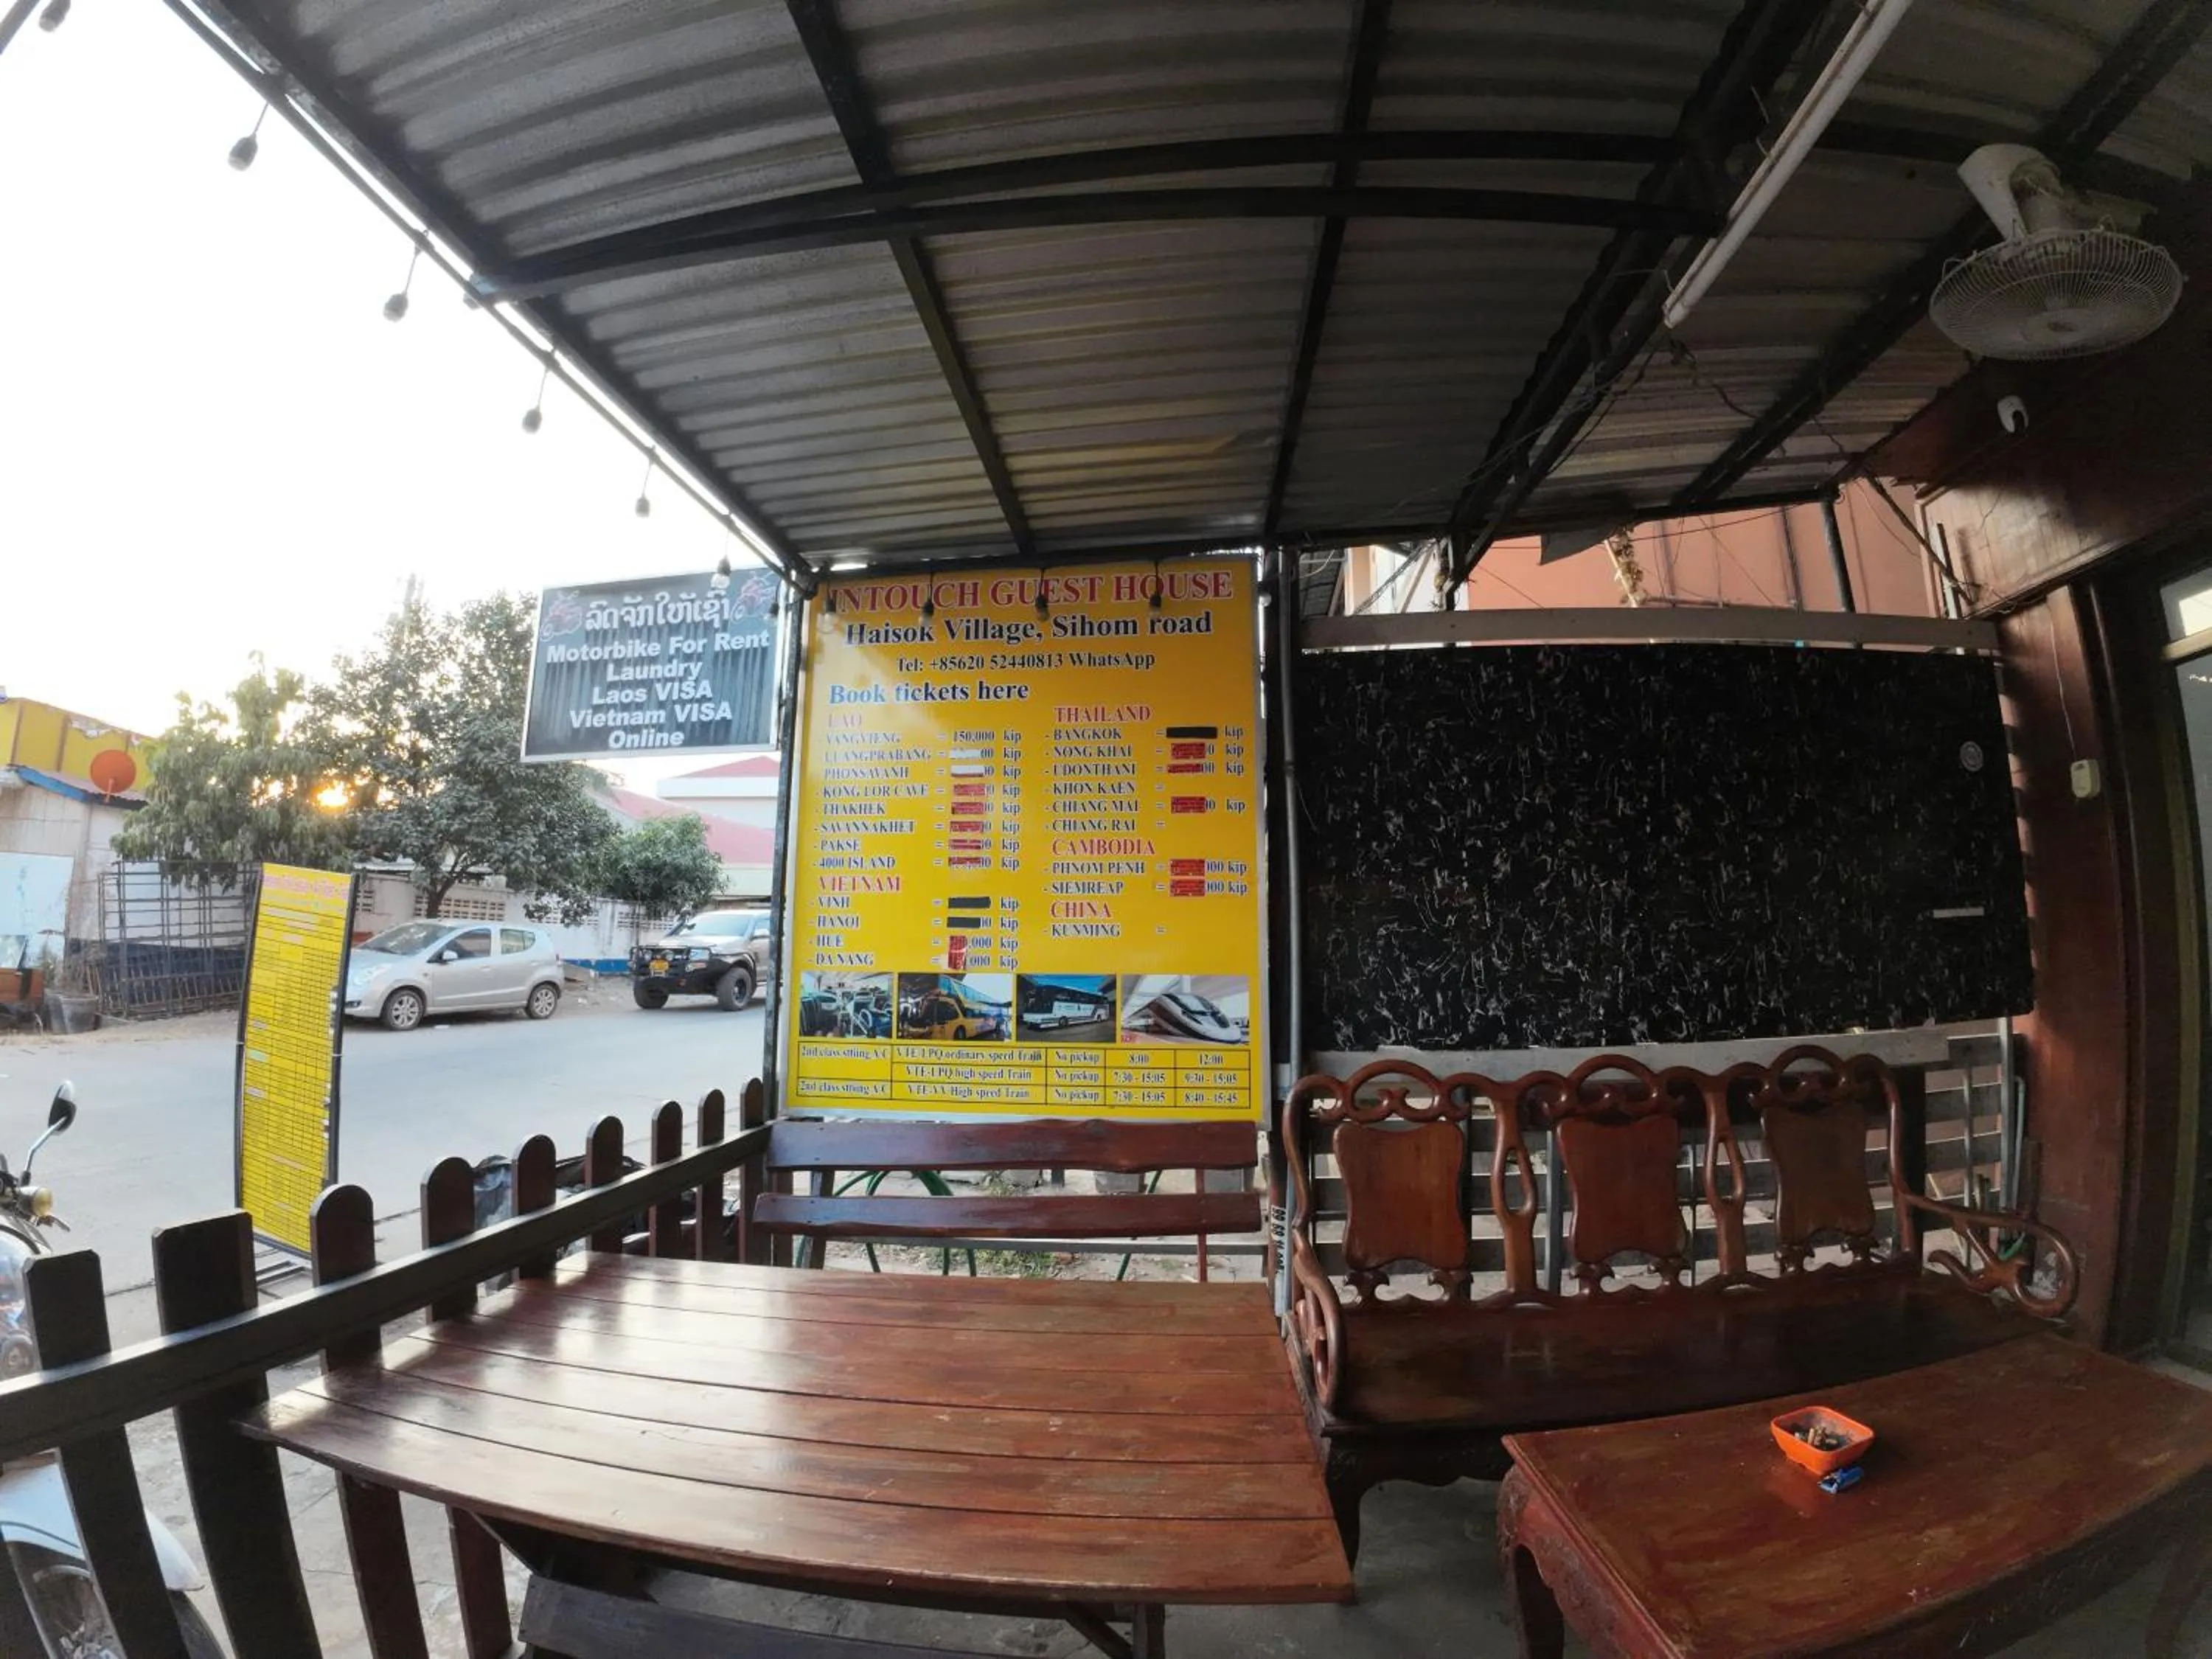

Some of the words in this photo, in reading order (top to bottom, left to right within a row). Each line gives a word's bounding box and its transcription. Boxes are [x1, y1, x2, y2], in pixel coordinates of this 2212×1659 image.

[990, 576, 1104, 605] GUEST
[1113, 572, 1233, 601] HOUSE
[846, 621, 934, 644] Haisok
[944, 618, 1043, 644] Village,
[1052, 613, 1138, 637] Sihom
[1149, 611, 1211, 634] road
[546, 639, 661, 664] Motorbike
[669, 636, 708, 655] For
[714, 629, 769, 652] Rent
[607, 659, 703, 681] Laundry
[897, 658, 923, 672] Tel:
[931, 655, 984, 670] +85620
[990, 653, 1063, 669] 52440813
[592, 686, 647, 706] Laos
[655, 680, 712, 700] VISA
[830, 684, 886, 703] Book
[895, 682, 970, 700] tickets
[978, 681, 1029, 699] here
[569, 710, 665, 728] Vietnam
[674, 701, 733, 722] VISA
[828, 714, 862, 728] LAO
[1054, 706, 1152, 723] THAILAND
[608, 729, 684, 748] Online
[1004, 729, 1021, 742] kip
[1054, 727, 1122, 740] BANGKOK
[1224, 725, 1244, 739] kip
[1004, 747, 1021, 760] kip
[1054, 745, 1092, 757] NONG
[1096, 744, 1131, 757] KHAI
[1225, 743, 1244, 757] kip
[1003, 765, 1021, 779] kip
[1225, 762, 1245, 776] kip
[823, 785, 860, 799] KONG
[894, 784, 928, 796] CAVE
[1002, 784, 1020, 797] kip
[1053, 782, 1092, 794] KHON
[1097, 781, 1135, 793] KAEN
[824, 802, 886, 815] THAKHEK
[1002, 801, 1020, 815] kip
[1052, 800, 1107, 813] CHIANG
[1111, 799, 1138, 812] MAI
[1225, 799, 1245, 813] kip
[1002, 820, 1020, 834] kip
[1052, 818, 1107, 832] CHIANG
[1111, 818, 1135, 831] RAI
[821, 839, 860, 851] PAKSE
[1002, 838, 1020, 852] kip
[1052, 838, 1155, 855] CAMBODIA
[848, 856, 897, 869] ISLAND
[1001, 856, 1020, 871] kip
[1052, 861, 1103, 874] PHNOM
[1107, 861, 1145, 874] PENH
[1228, 860, 1247, 875] kip
[819, 875, 901, 891] VIETNAM
[1051, 881, 1124, 894] SIEMREAP
[1228, 880, 1248, 895] kip
[1001, 897, 1018, 911] kip
[1050, 900, 1112, 918] CHINA
[817, 915, 860, 927] HANOI
[1001, 916, 1018, 930] kip
[1051, 924, 1121, 937] KUNMING
[816, 934, 844, 947] HUE
[1000, 935, 1018, 951] kip
[999, 953, 1018, 970] kip
[988, 1050, 1014, 1062] speed
[978, 1068, 1003, 1080] speed
[1007, 1068, 1032, 1080] Train
[975, 1087, 1001, 1099] speed
